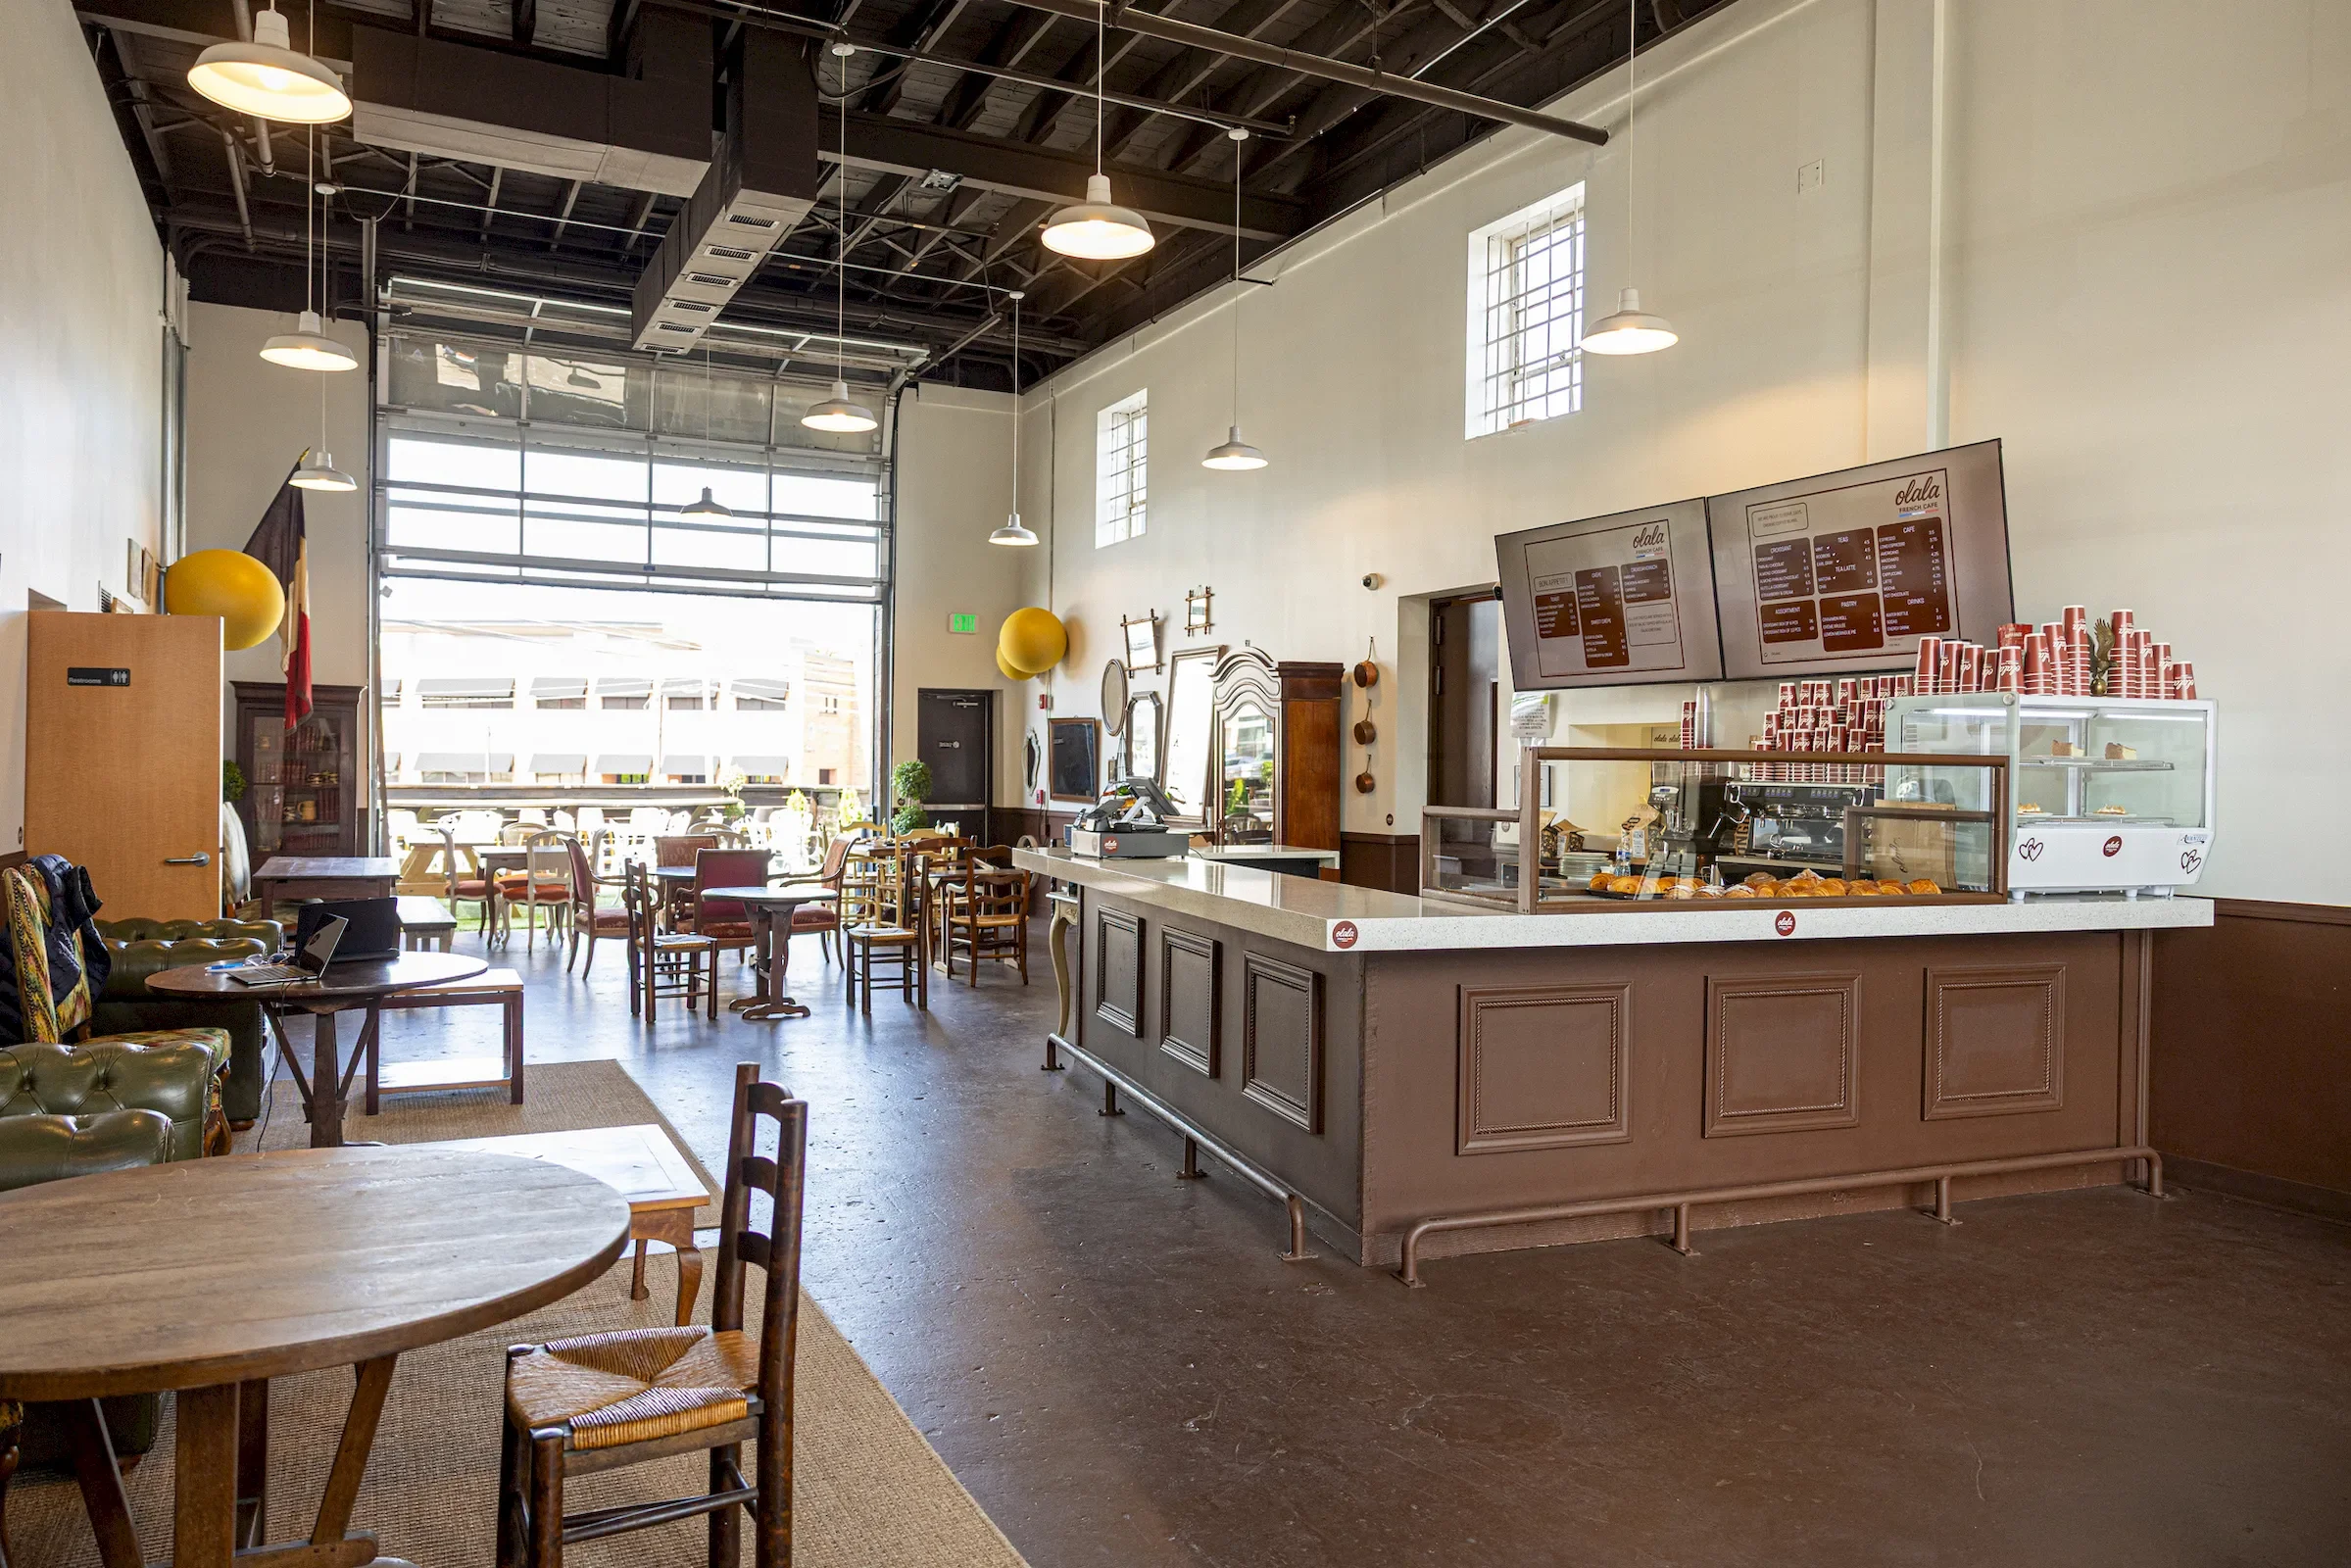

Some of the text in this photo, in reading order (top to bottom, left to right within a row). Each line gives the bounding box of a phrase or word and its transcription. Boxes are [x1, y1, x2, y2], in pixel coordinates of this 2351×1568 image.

[1896, 476, 1940, 505] olala
[1633, 525, 1664, 548] olala
[1770, 545, 1791, 553] CROISSANT
[1777, 917, 1793, 926] olala
[1336, 928, 1354, 937] olala
